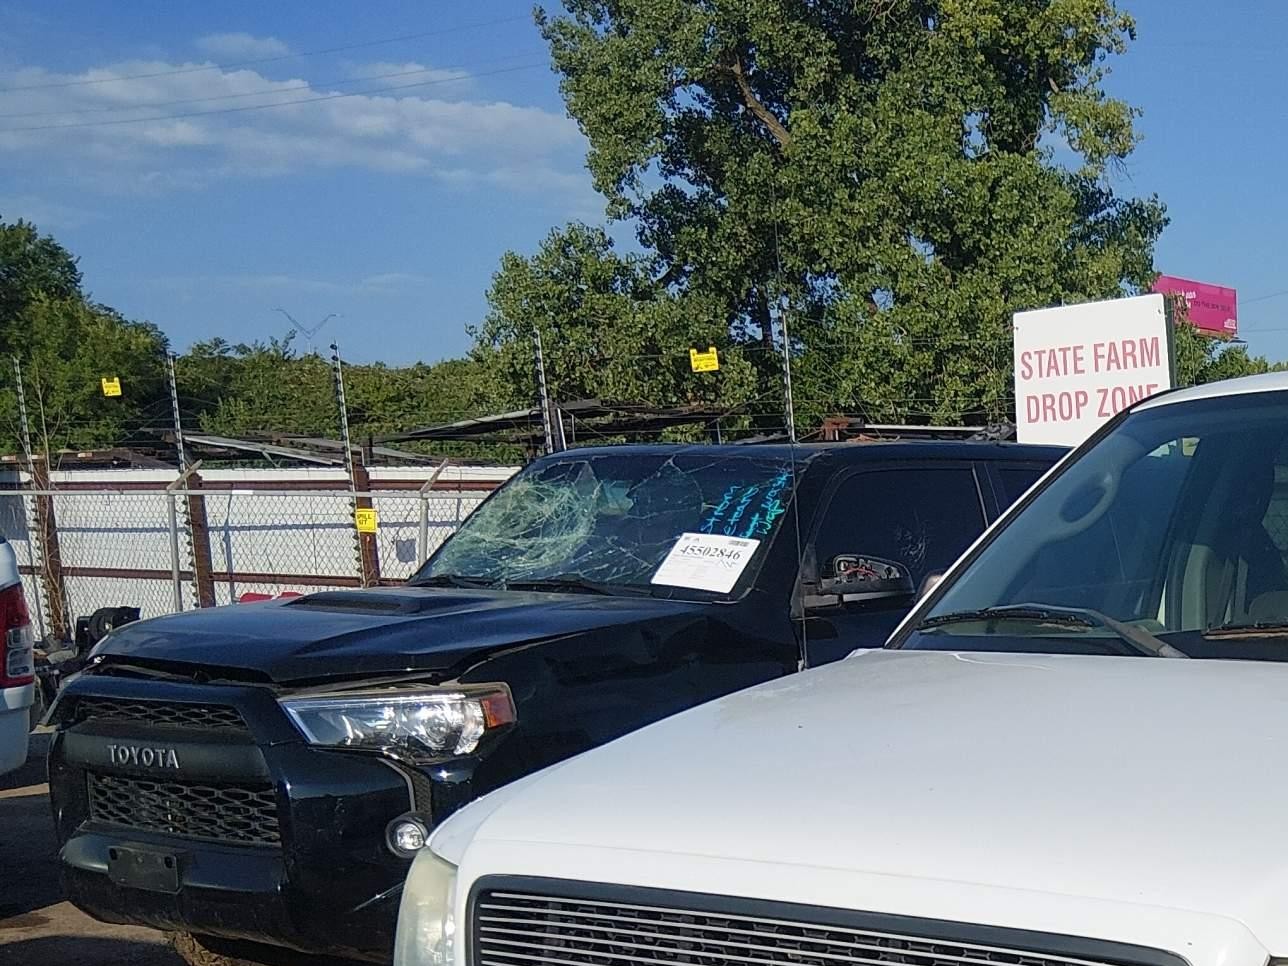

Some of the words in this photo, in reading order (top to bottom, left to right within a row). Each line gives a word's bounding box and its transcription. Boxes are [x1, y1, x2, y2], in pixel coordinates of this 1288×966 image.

[1020, 345, 1085, 380] STATE
[1093, 337, 1161, 373] FARM
[1026, 390, 1089, 424] DROP
[680, 544, 741, 560] 45502846
[107, 744, 180, 769] TOYOTA
